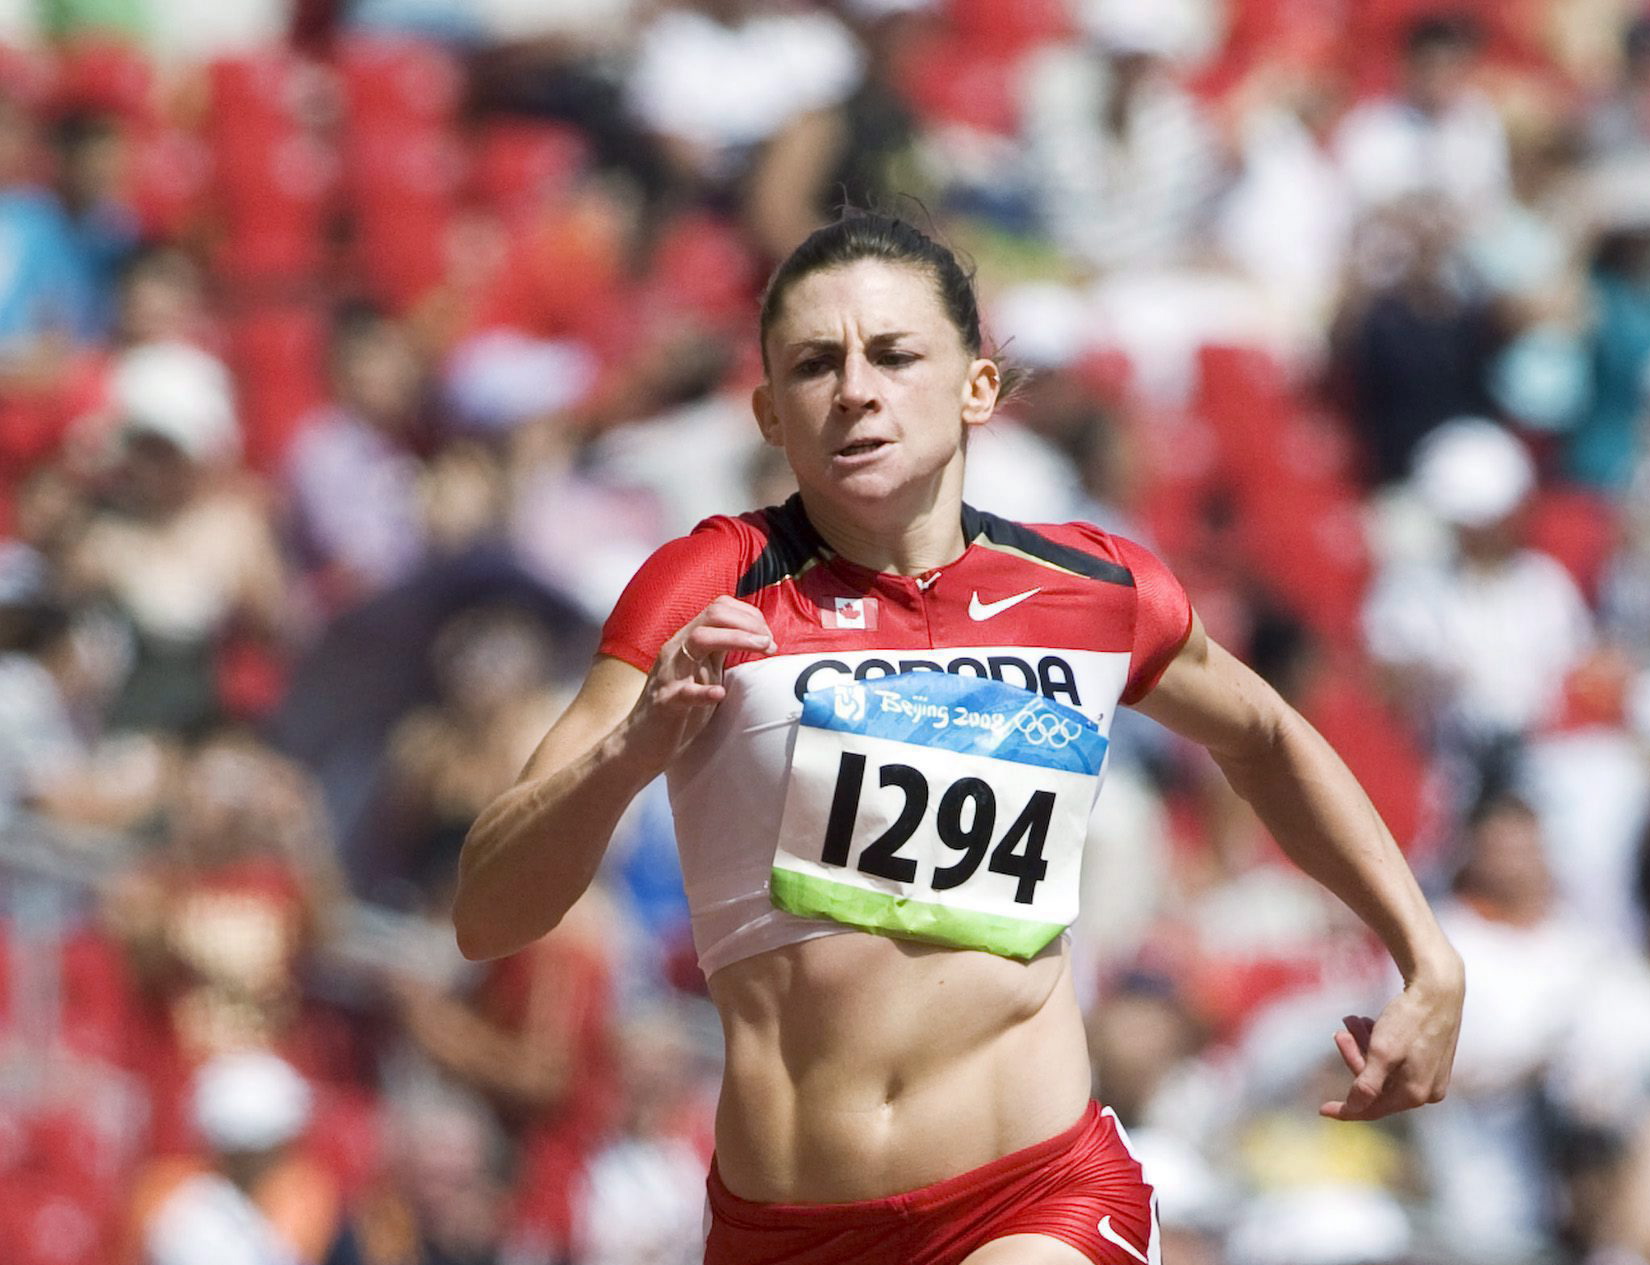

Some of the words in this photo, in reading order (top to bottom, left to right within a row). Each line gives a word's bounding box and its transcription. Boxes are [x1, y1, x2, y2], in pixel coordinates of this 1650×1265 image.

[794, 656, 1080, 706] CDA
[874, 690, 949, 728] Beijing
[953, 707, 1006, 731] 2008
[821, 751, 1057, 904] 1294
